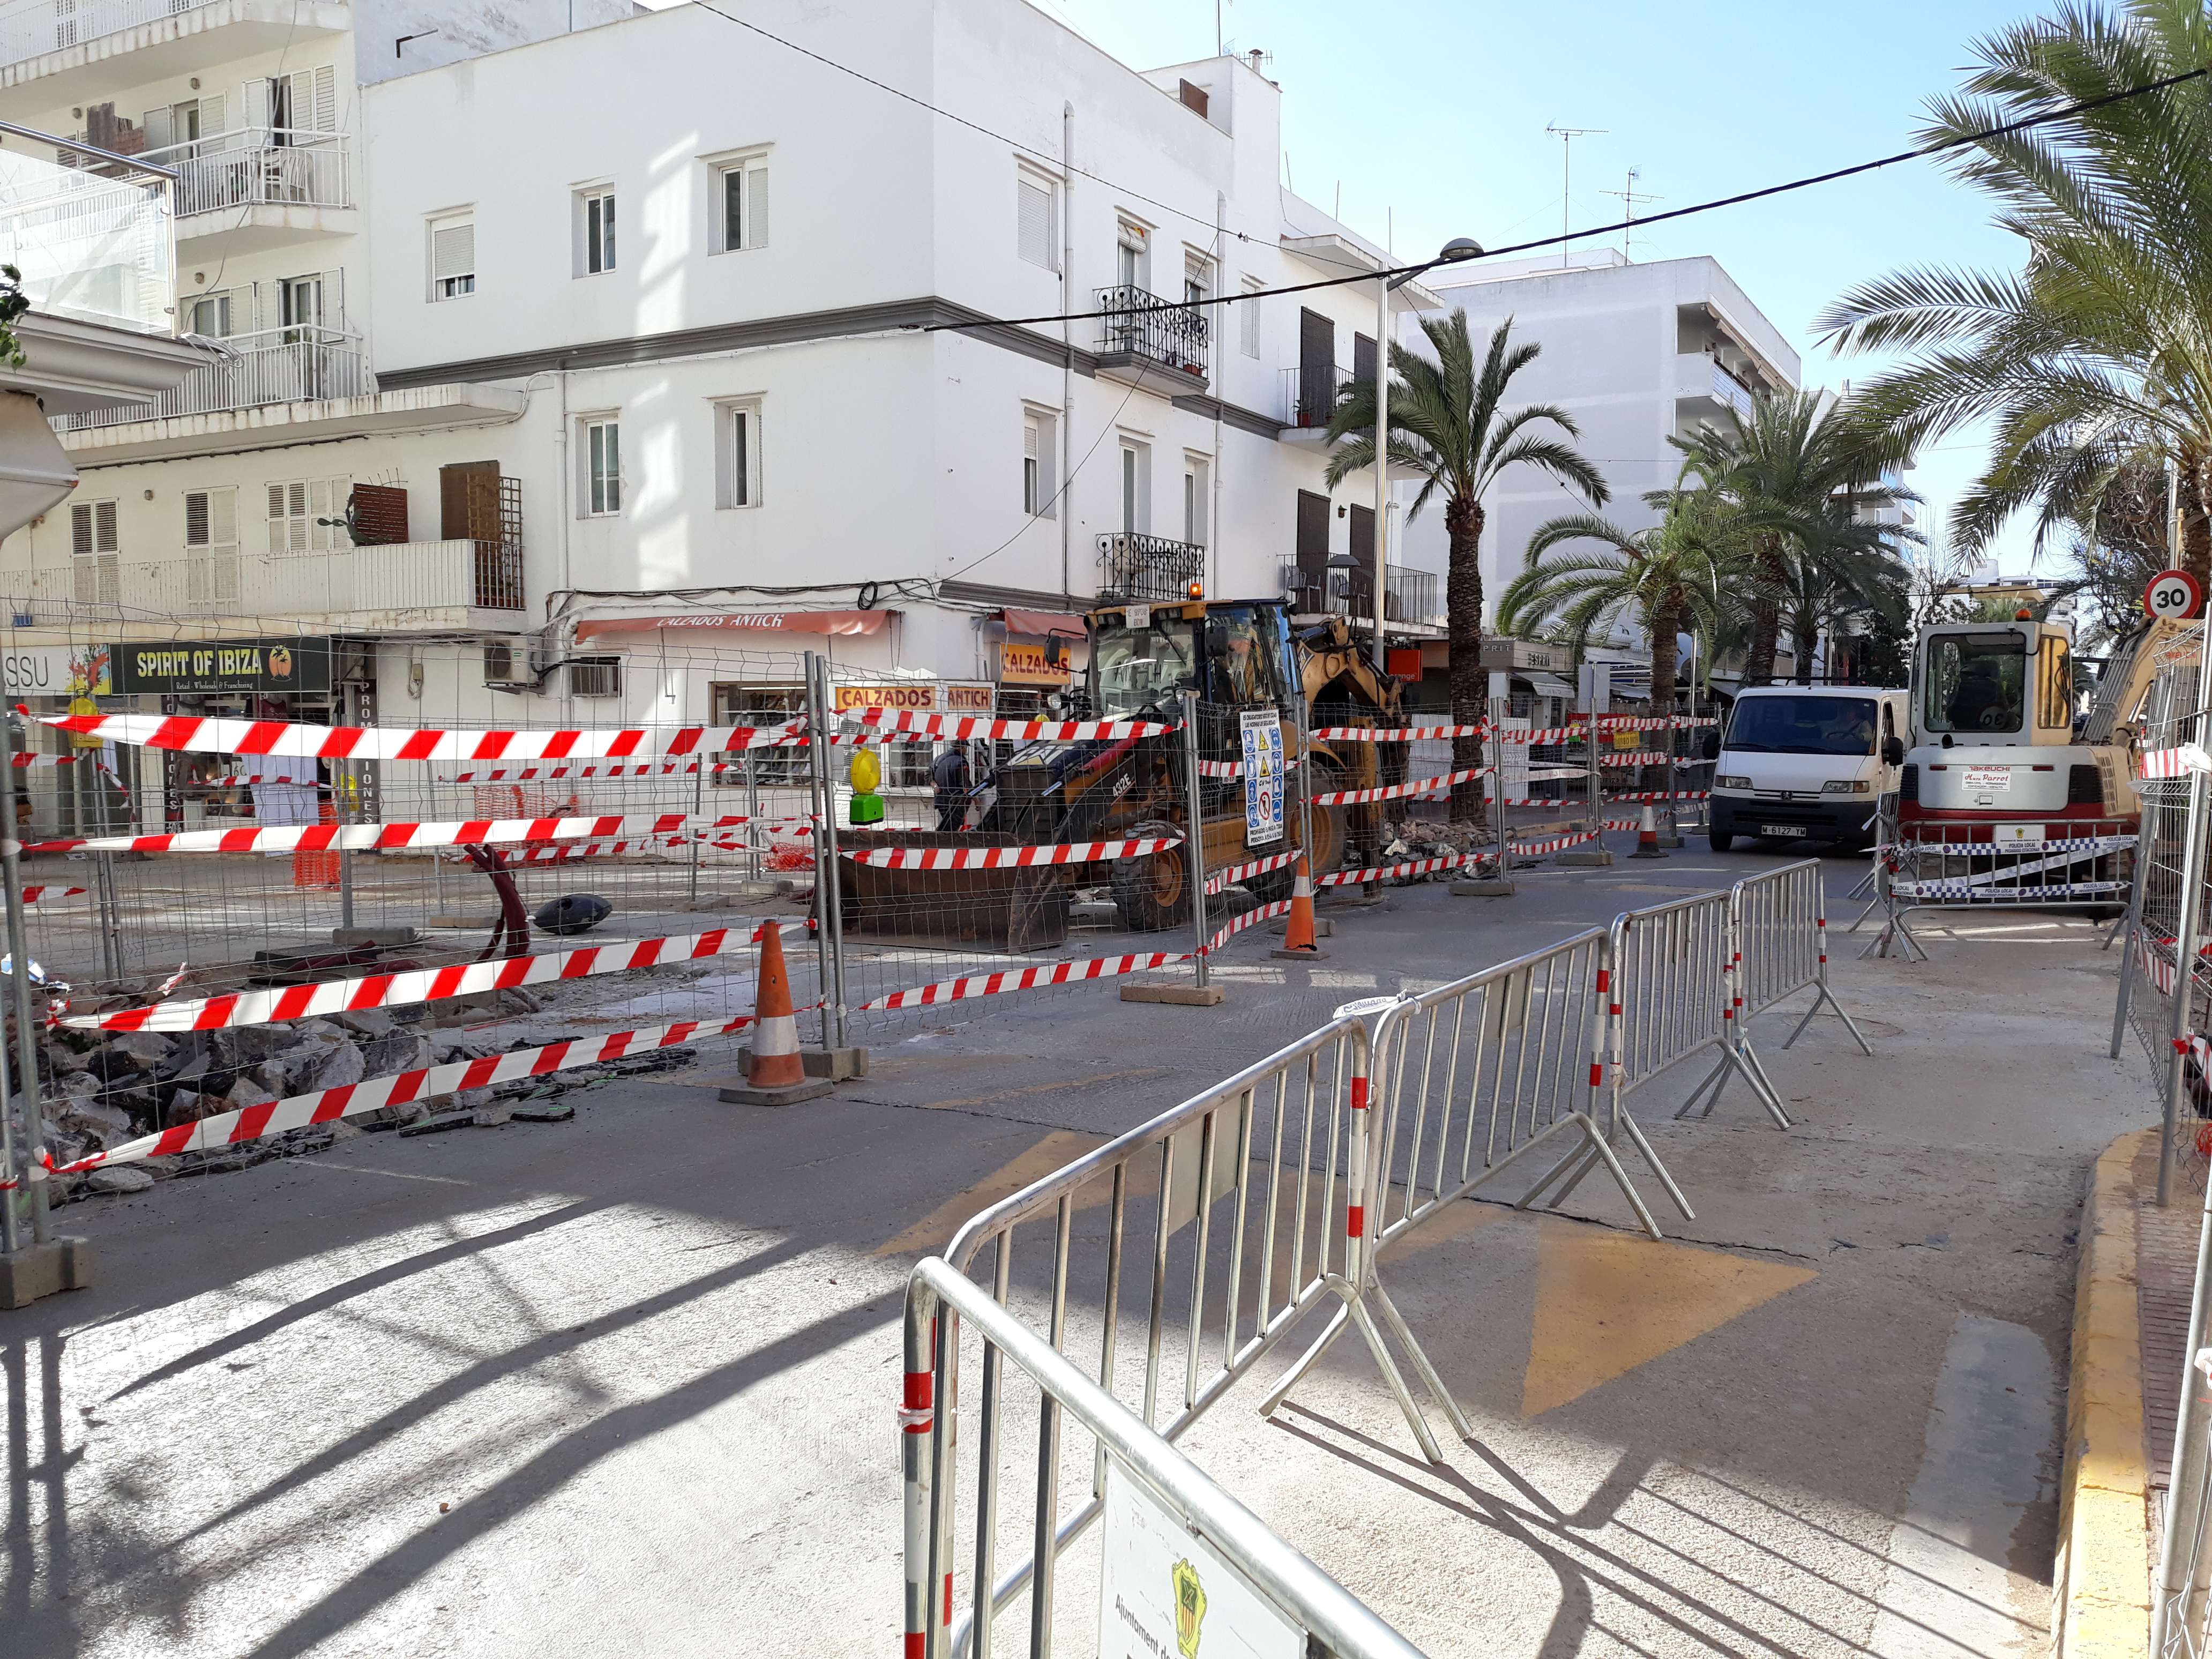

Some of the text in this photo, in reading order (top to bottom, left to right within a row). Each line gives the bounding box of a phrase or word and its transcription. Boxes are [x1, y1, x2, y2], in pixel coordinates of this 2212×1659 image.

[2156, 588, 2185, 608] 30
[657, 616, 727, 626] CALZADOS
[137, 648, 263, 677] SPIRIT OF IBIZA
[176, 681, 190, 690] Retail
[224, 679, 253, 690] Franchising
[842, 690, 989, 707] CALZADOS ANTICH
[1112, 772, 1131, 798] 432E
[1115, 1593, 1158, 1656] Ajuntament
